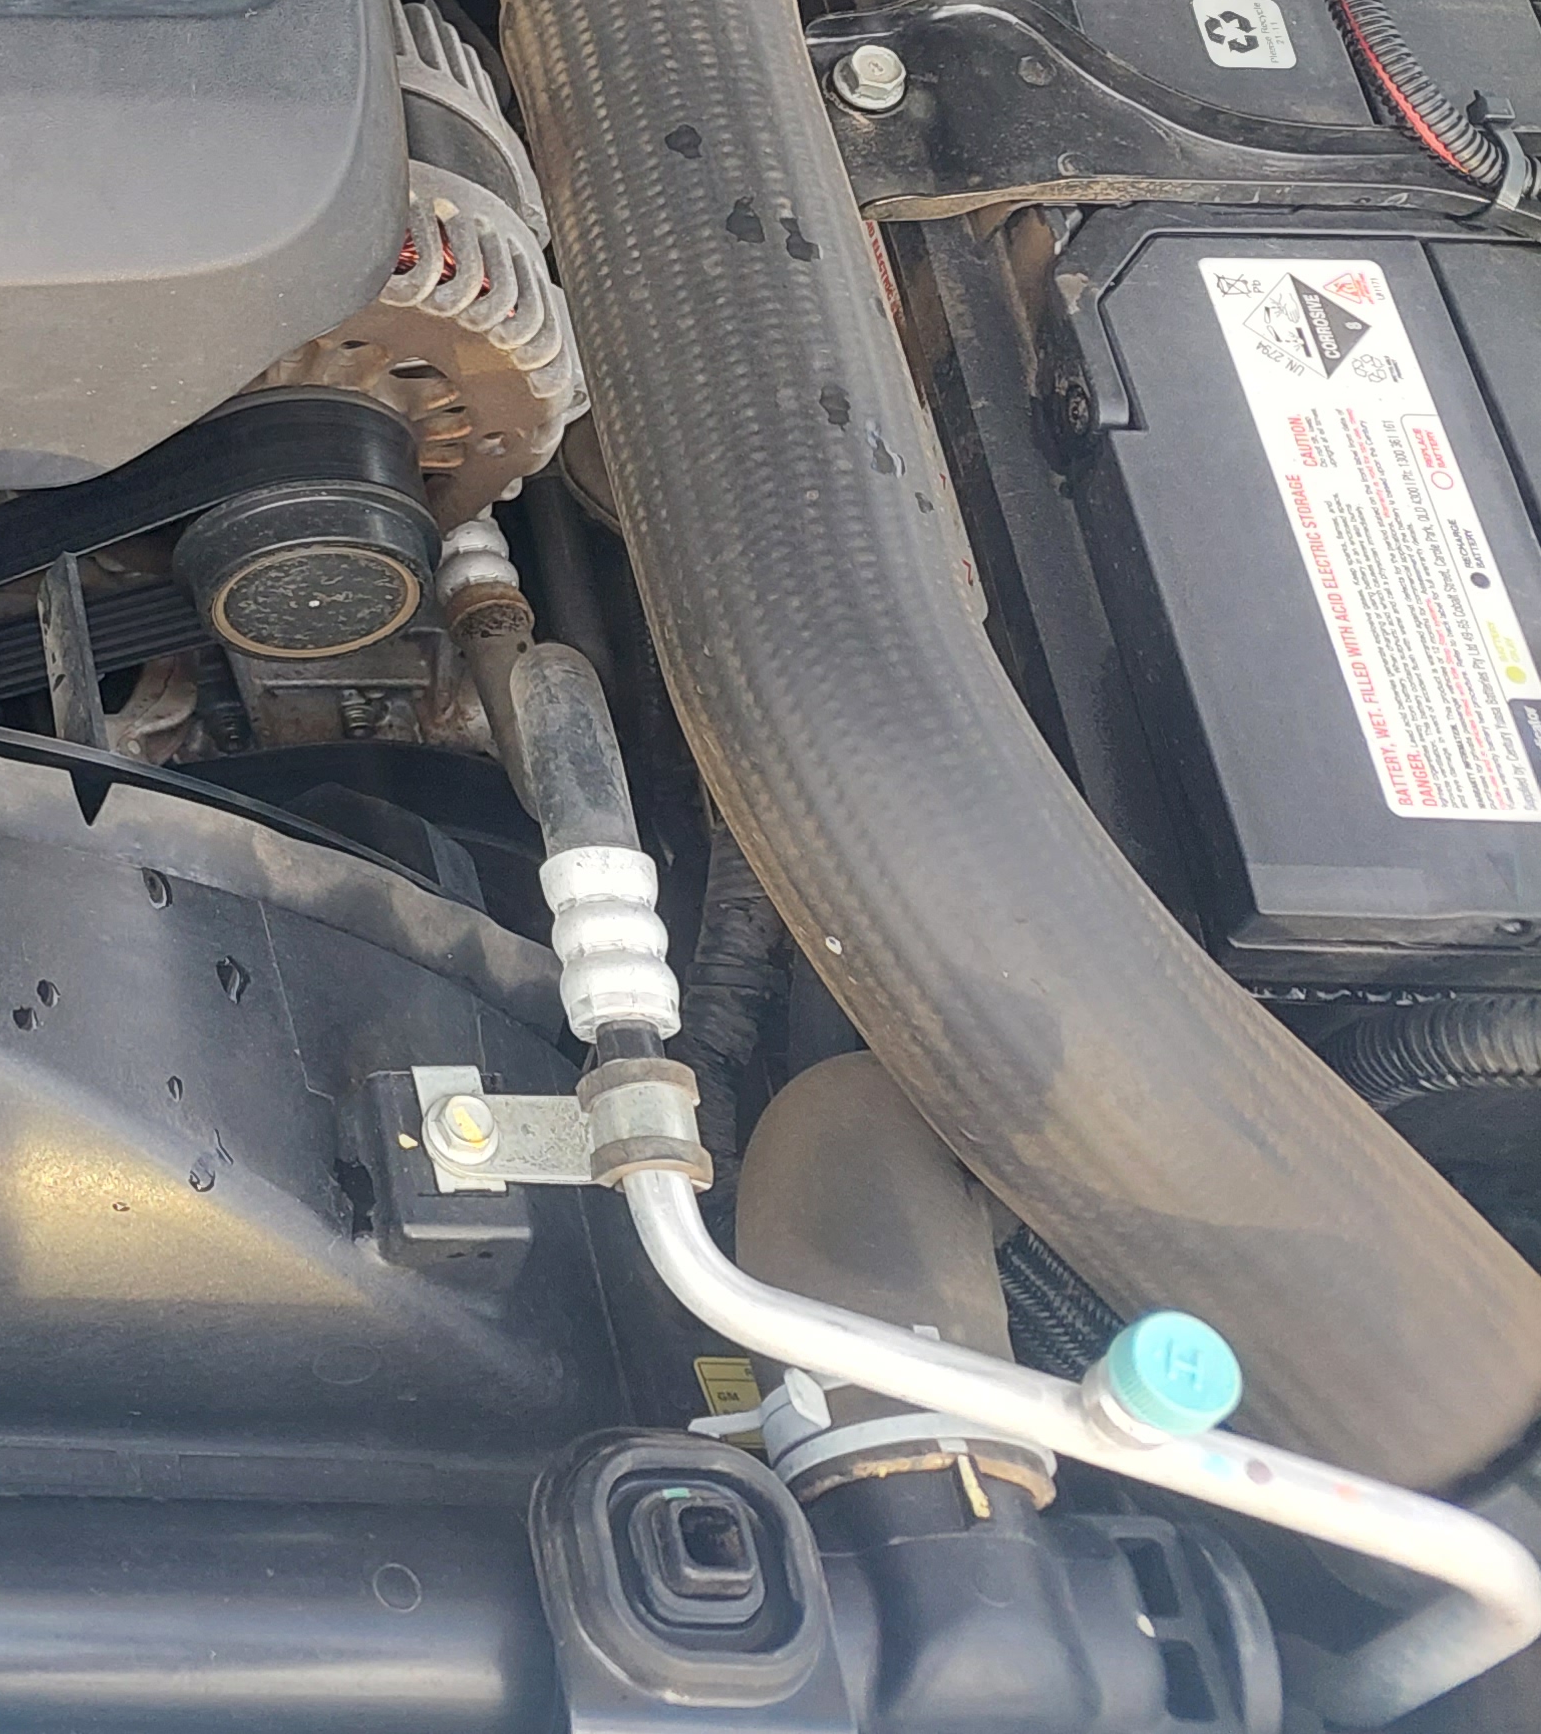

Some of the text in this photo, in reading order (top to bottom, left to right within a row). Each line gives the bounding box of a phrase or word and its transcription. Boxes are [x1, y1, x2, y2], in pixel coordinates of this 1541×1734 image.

[1253, 2, 1278, 63] Please Recycle
[1251, 279, 1264, 293] Pb
[1303, 294, 1339, 358] CORROSIVE
[1345, 321, 1361, 329] 8
[1256, 341, 1283, 362] 2794
[1288, 417, 1317, 466] CAUTION.
[1285, 475, 1412, 805] BATTERY, WET. FILLED WITH ACID ELECTRIC STORAGE
[1500, 731, 1518, 761] Century
[1407, 751, 1436, 806] DANGER.
[716, 1391, 739, 1401] GM
